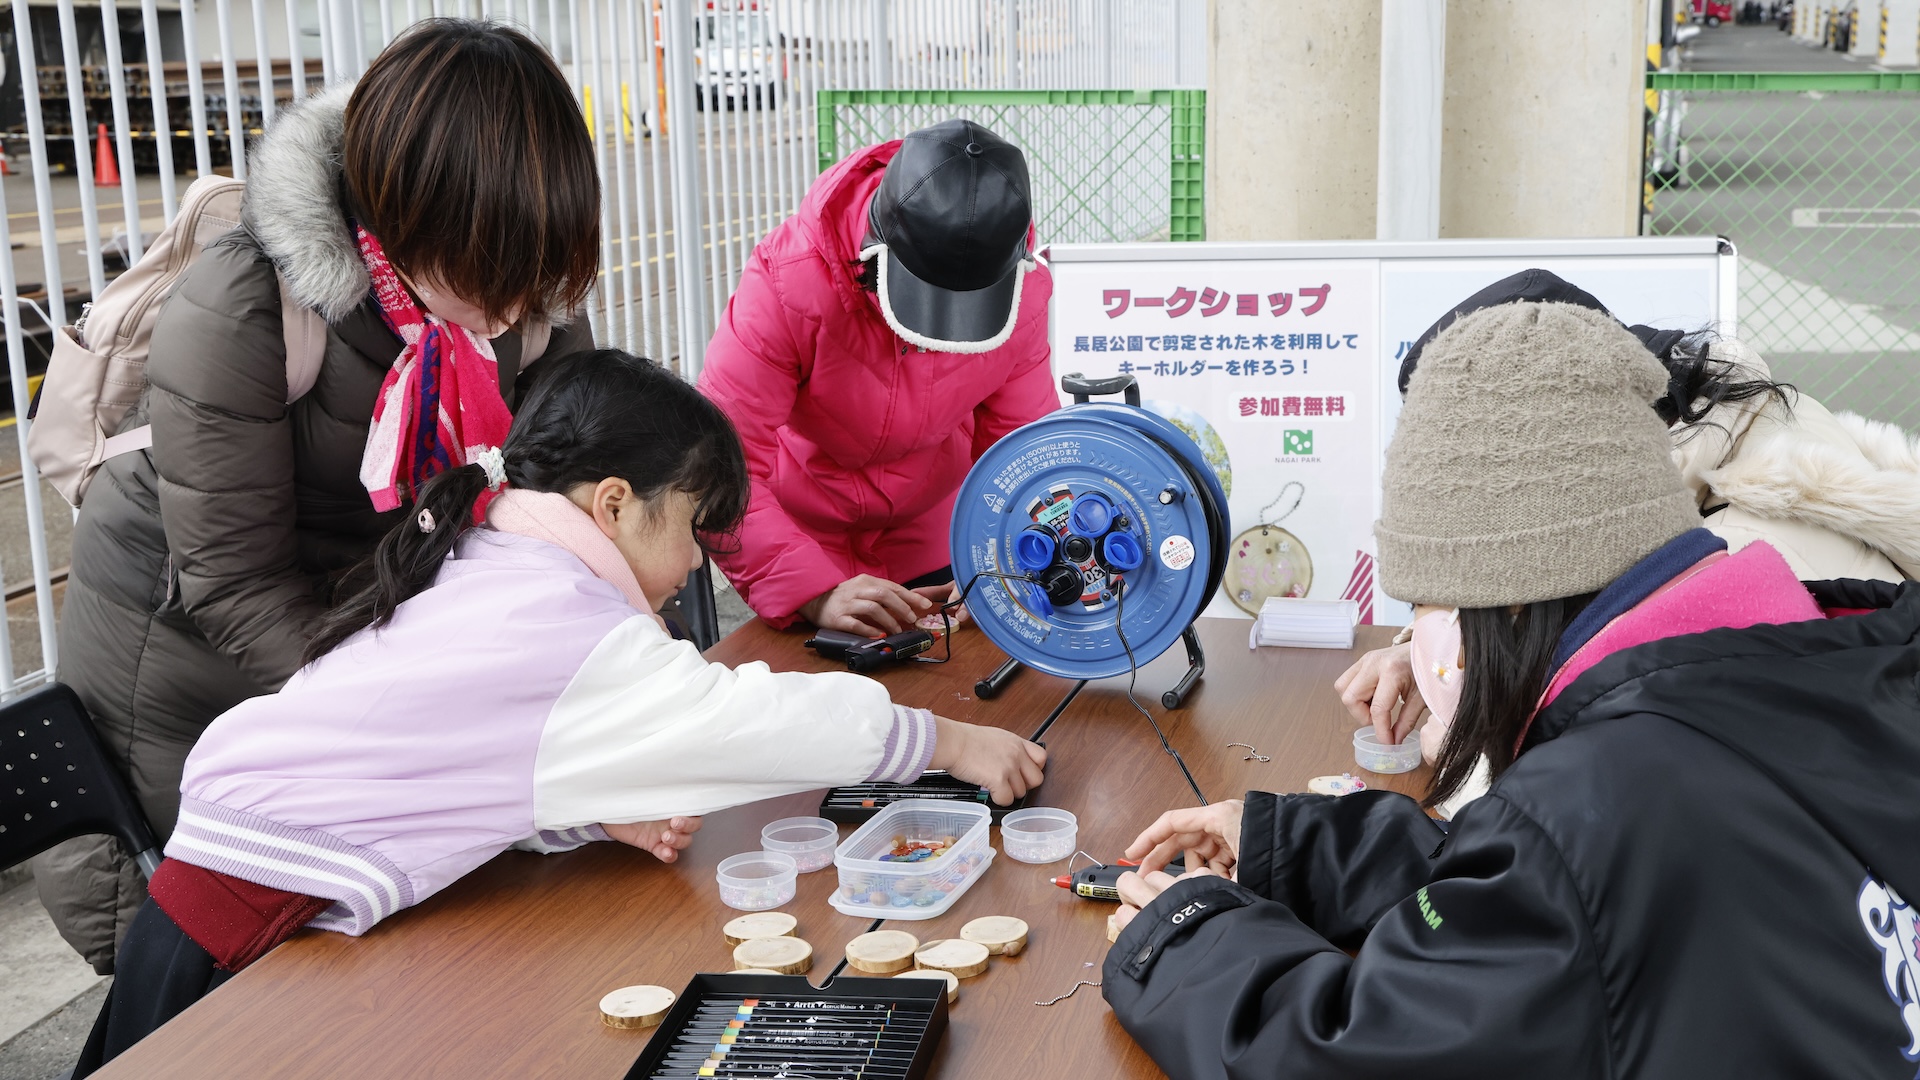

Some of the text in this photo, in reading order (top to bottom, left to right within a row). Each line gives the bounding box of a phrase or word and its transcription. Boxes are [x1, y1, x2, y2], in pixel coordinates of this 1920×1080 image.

[1102, 283, 1332, 319] ワークショップ
[1073, 333, 1359, 353] 長居公園で剪定された木を利用して
[1238, 396, 1346, 417] 参加費無料
[1171, 901, 1207, 925] 120
